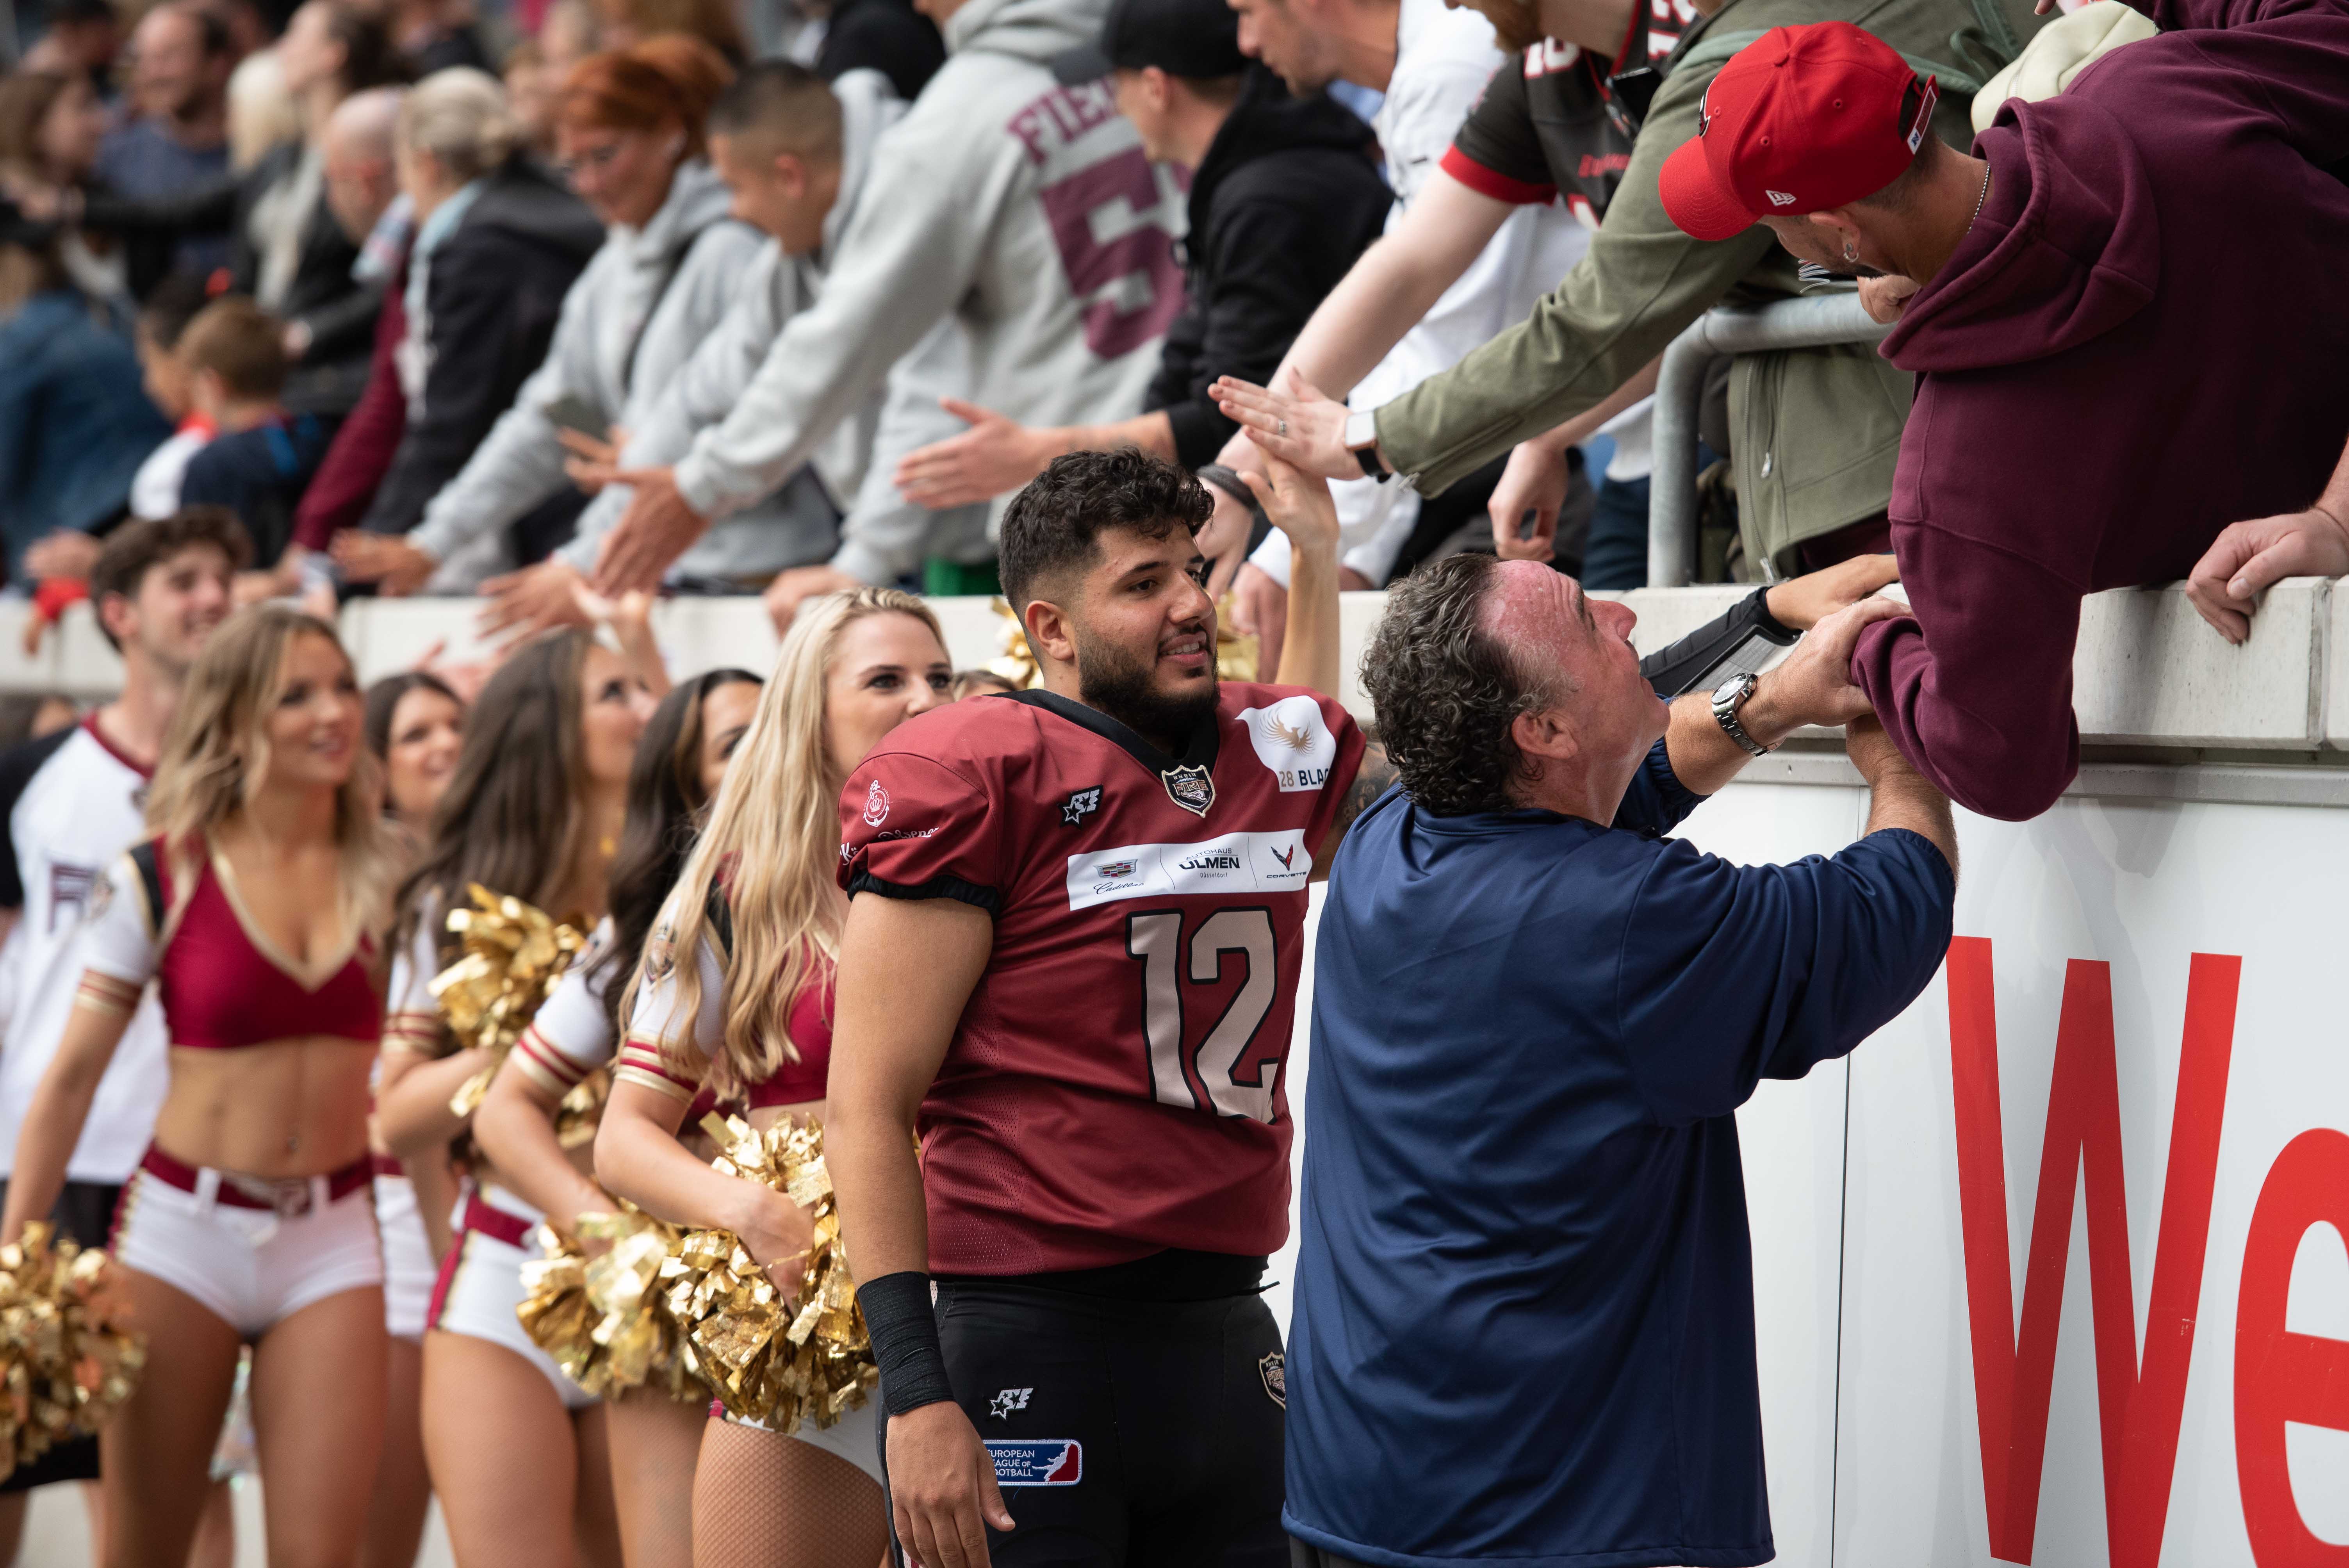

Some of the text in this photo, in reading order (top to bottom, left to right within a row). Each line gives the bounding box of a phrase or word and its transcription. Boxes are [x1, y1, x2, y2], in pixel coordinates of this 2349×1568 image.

[1003, 77, 1114, 166] FIE
[1040, 144, 1189, 361] 5
[1279, 770, 1294, 787] 28
[1172, 779, 1209, 796] FIRE
[1186, 848, 1232, 860] AUTOHAUS
[1178, 857, 1240, 870] ULMEN
[1125, 905, 1279, 1125] 12
[1946, 935, 2349, 1568] We
[987, 1449, 1035, 1458] UROPEAN
[995, 1468, 1033, 1477] OTBALL
